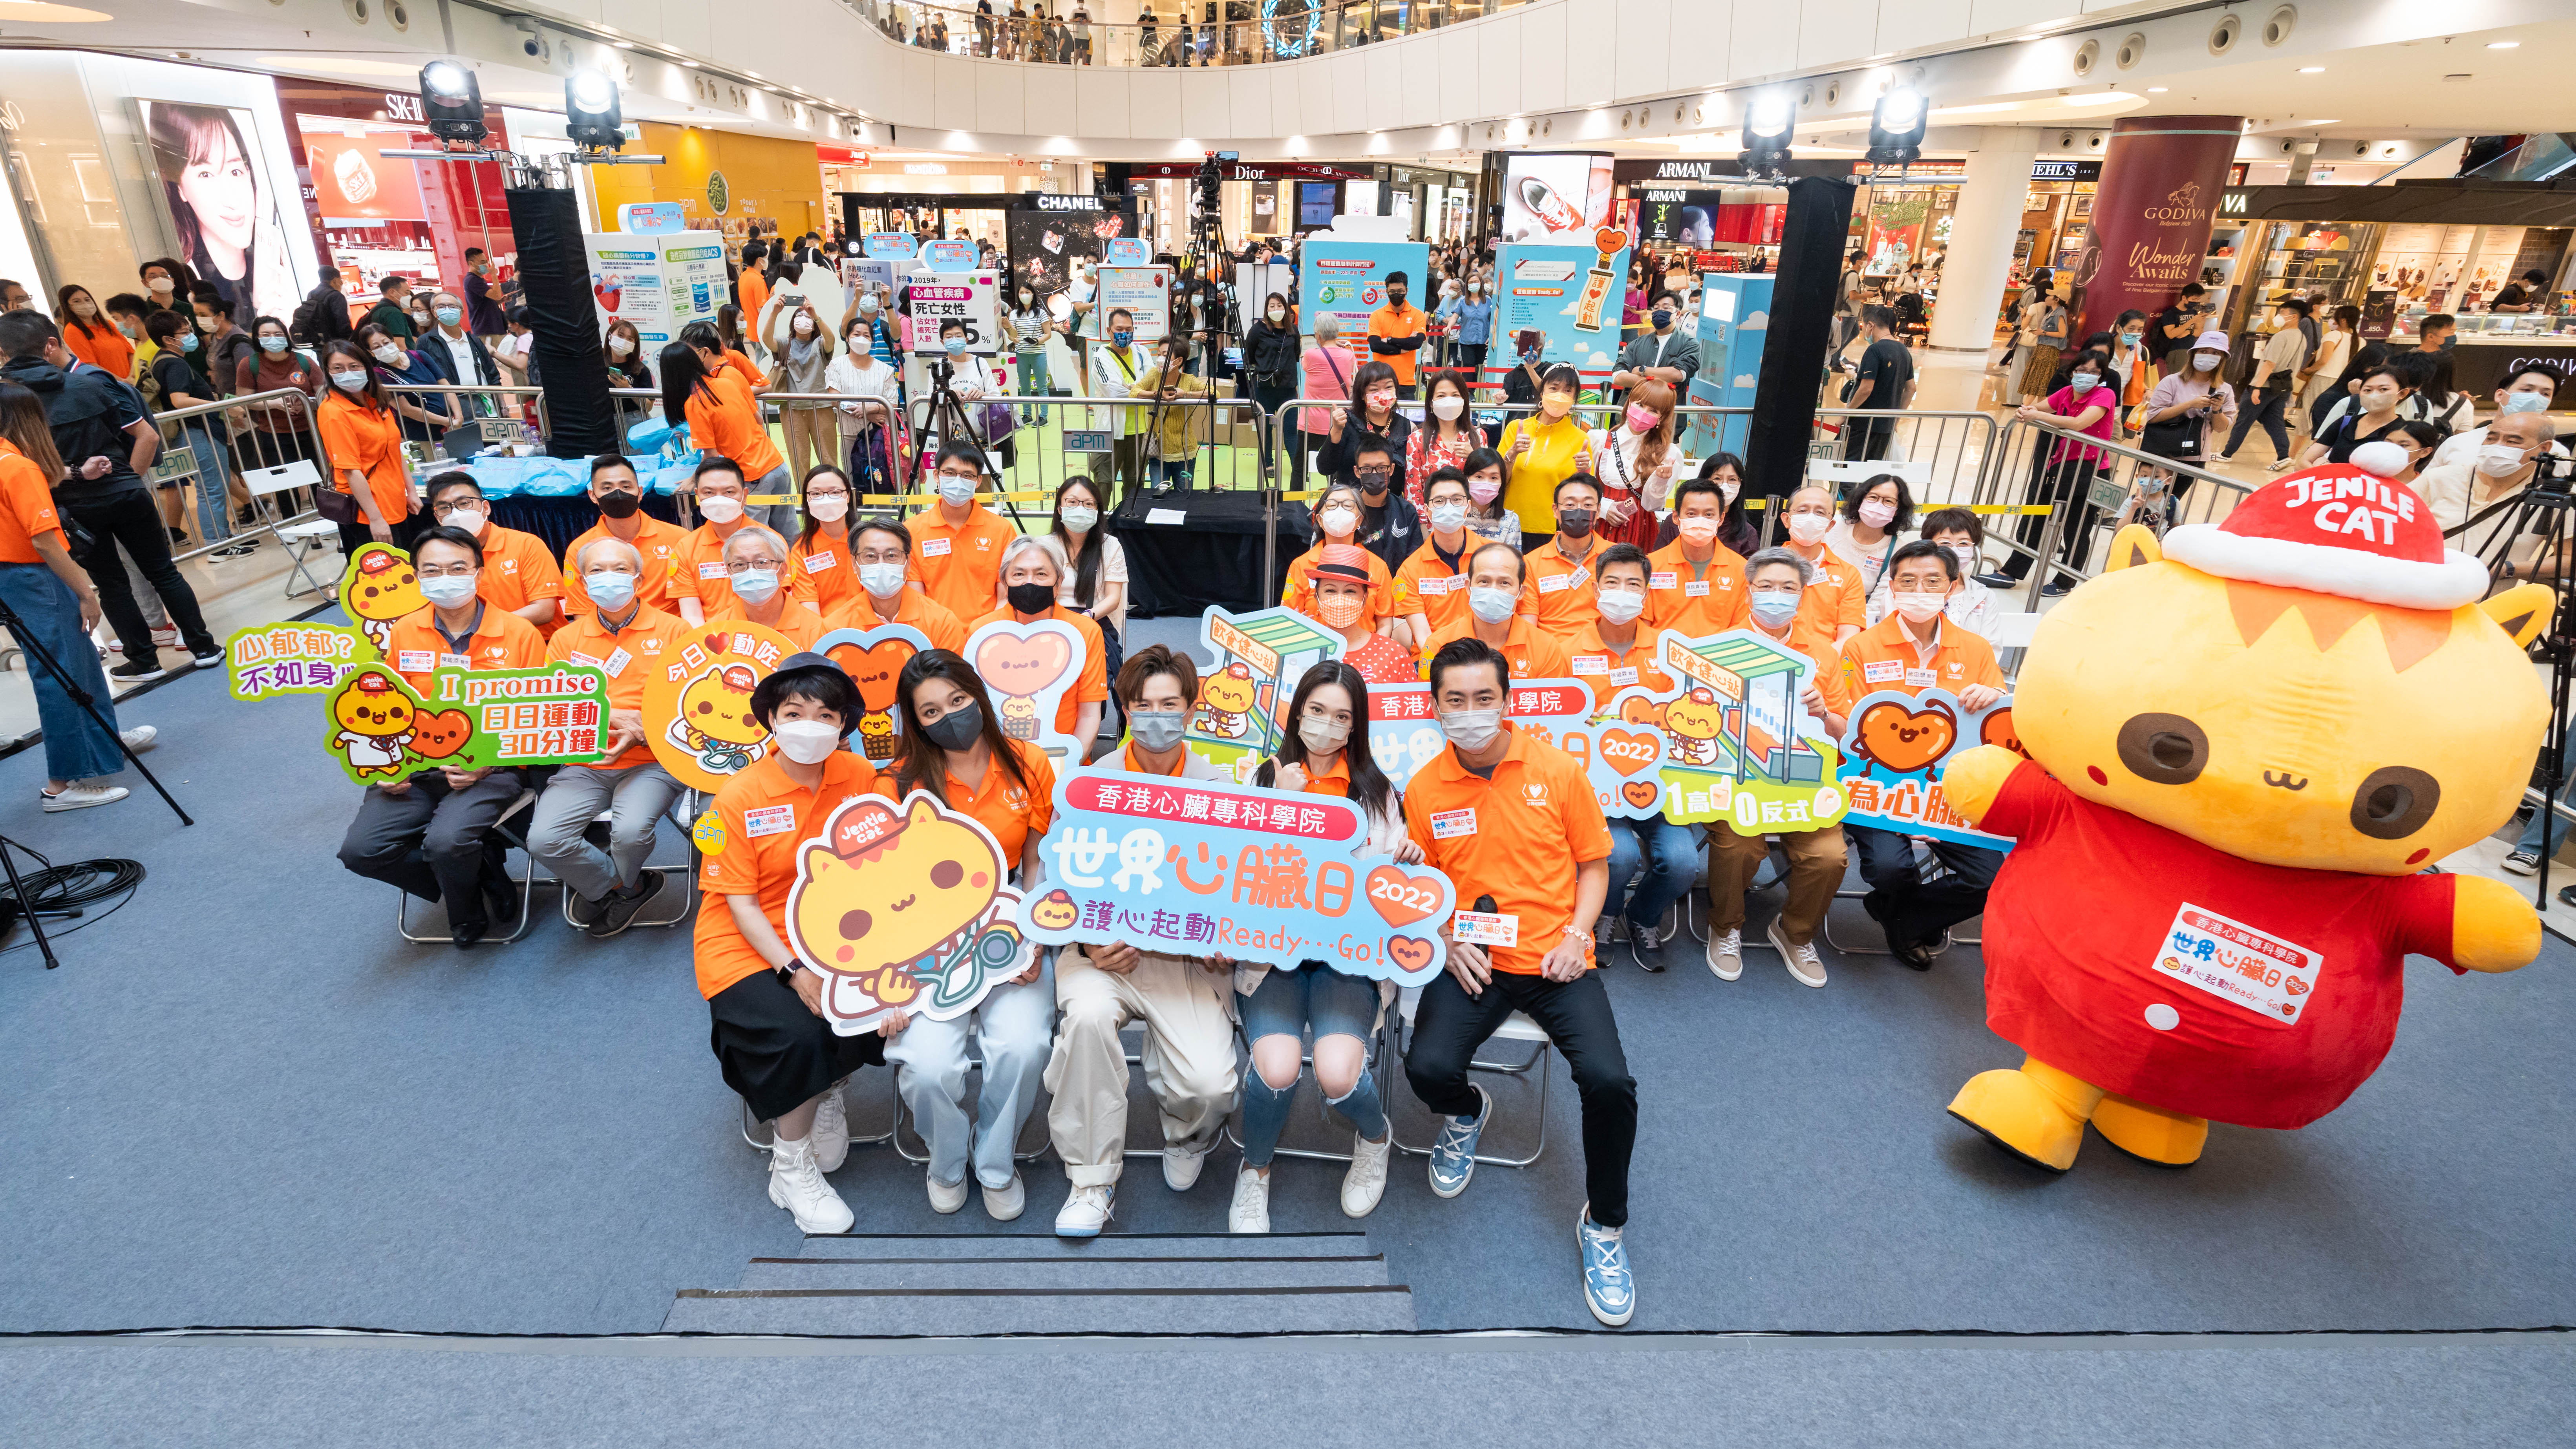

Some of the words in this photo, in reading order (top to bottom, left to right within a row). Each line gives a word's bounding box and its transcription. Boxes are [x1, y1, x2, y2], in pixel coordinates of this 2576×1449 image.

[386, 94, 424, 121] SK-II
[1234, 166, 1265, 179] Dior
[1398, 168, 1410, 182] Dior
[1656, 163, 1711, 177] ARMANI
[2032, 165, 2077, 176] IEHL'S
[1456, 175, 1466, 187] Dior
[1038, 196, 1104, 210] CHANEL
[1645, 190, 1686, 201] ARMANI
[2145, 207, 2205, 220] GODIVA
[2129, 237, 2196, 267] Wonder
[2130, 263, 2188, 280] Awaits
[913, 287, 964, 299] 心血管疾病
[915, 302, 966, 315] 死亡女性
[1620, 471, 1629, 485] YOUNG
[2285, 473, 2415, 523] JENTLE
[2314, 502, 2398, 545] CAT
[364, 553, 388, 566] Jentle
[1213, 621, 1274, 672] 飲食健心站
[241, 661, 351, 694] 不如身
[729, 672, 751, 683] Jentle
[1669, 642, 1740, 696] 飲食健心站
[363, 674, 383, 683] Jentle
[441, 675, 459, 700] I
[464, 671, 597, 706] promise
[483, 701, 600, 732] 日日運動
[499, 728, 598, 757] 30分鐘
[1603, 738, 1655, 762] 2022
[1095, 783, 1326, 834] 香港心臟專科學院
[841, 811, 888, 842] Jentle
[856, 827, 884, 845] cat
[1051, 827, 1355, 918] 世界心臟日
[1371, 876, 1437, 914] 2022
[1459, 921, 1501, 934] 世界心臟日
[2195, 916, 2298, 965] 香港心臟專科學院
[2172, 930, 2282, 988] 世界心臟日
